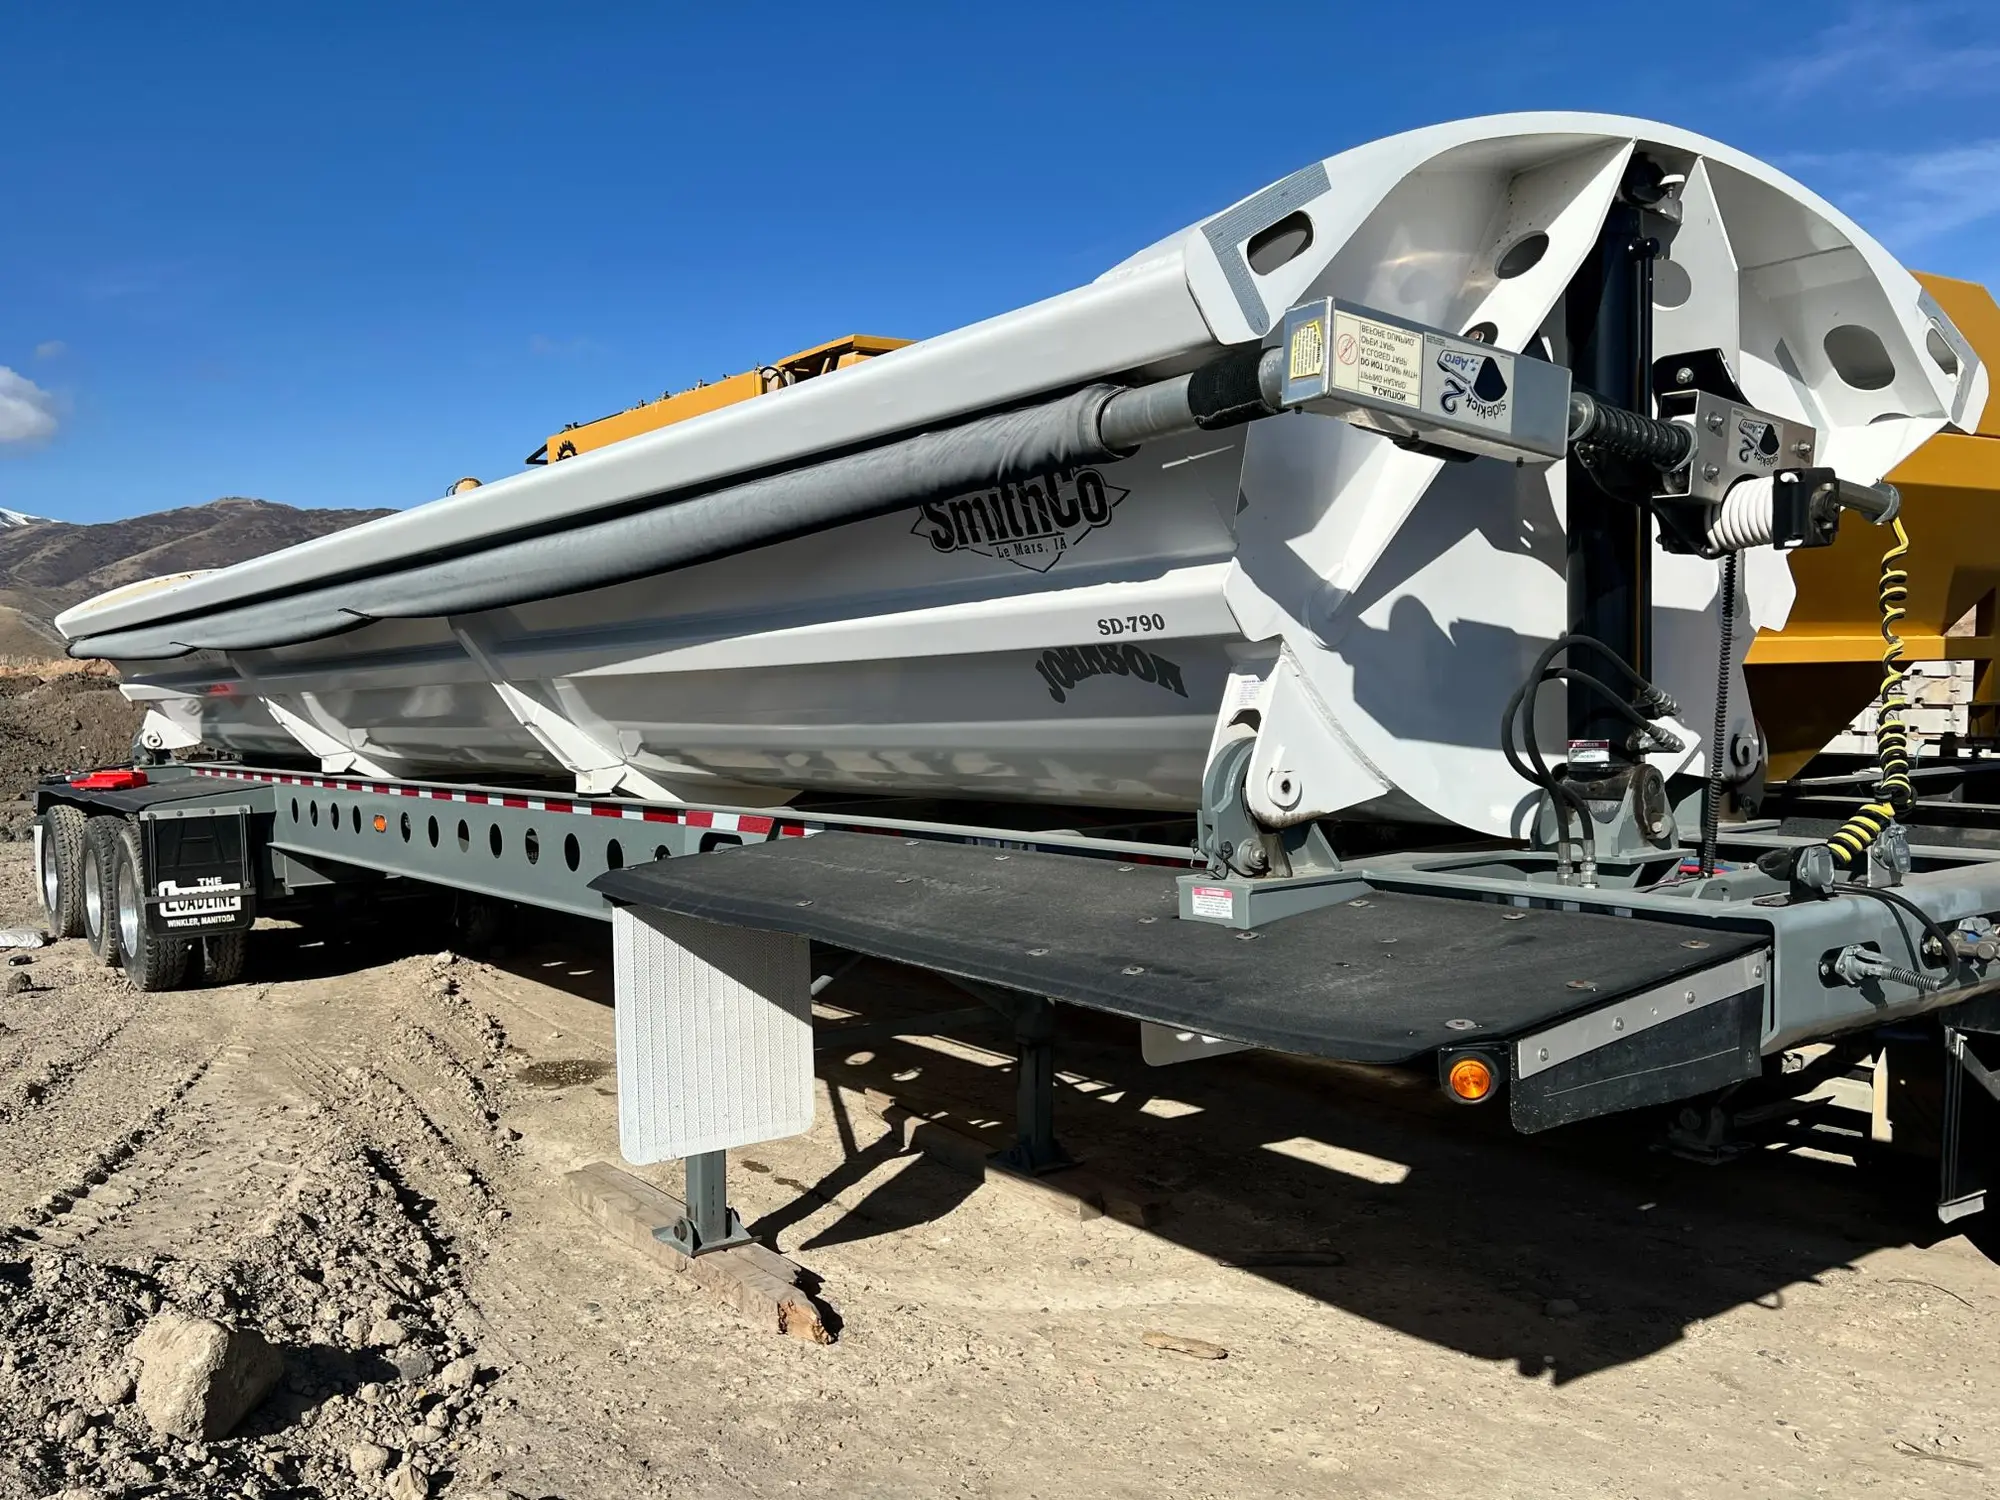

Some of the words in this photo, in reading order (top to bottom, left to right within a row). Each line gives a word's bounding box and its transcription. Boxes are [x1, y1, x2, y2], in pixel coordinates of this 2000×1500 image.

[1444, 353, 1469, 371] Aero
[1441, 376, 1466, 415] 2
[1466, 393, 1507, 420] sidekick
[996, 546, 1010, 559] Le
[1055, 536, 1068, 551] IA
[1097, 613, 1166, 636] SD-790
[1035, 643, 1189, 704] JOHNSON
[197, 876, 222, 887] THE
[201, 914, 235, 925] MANITOBA
